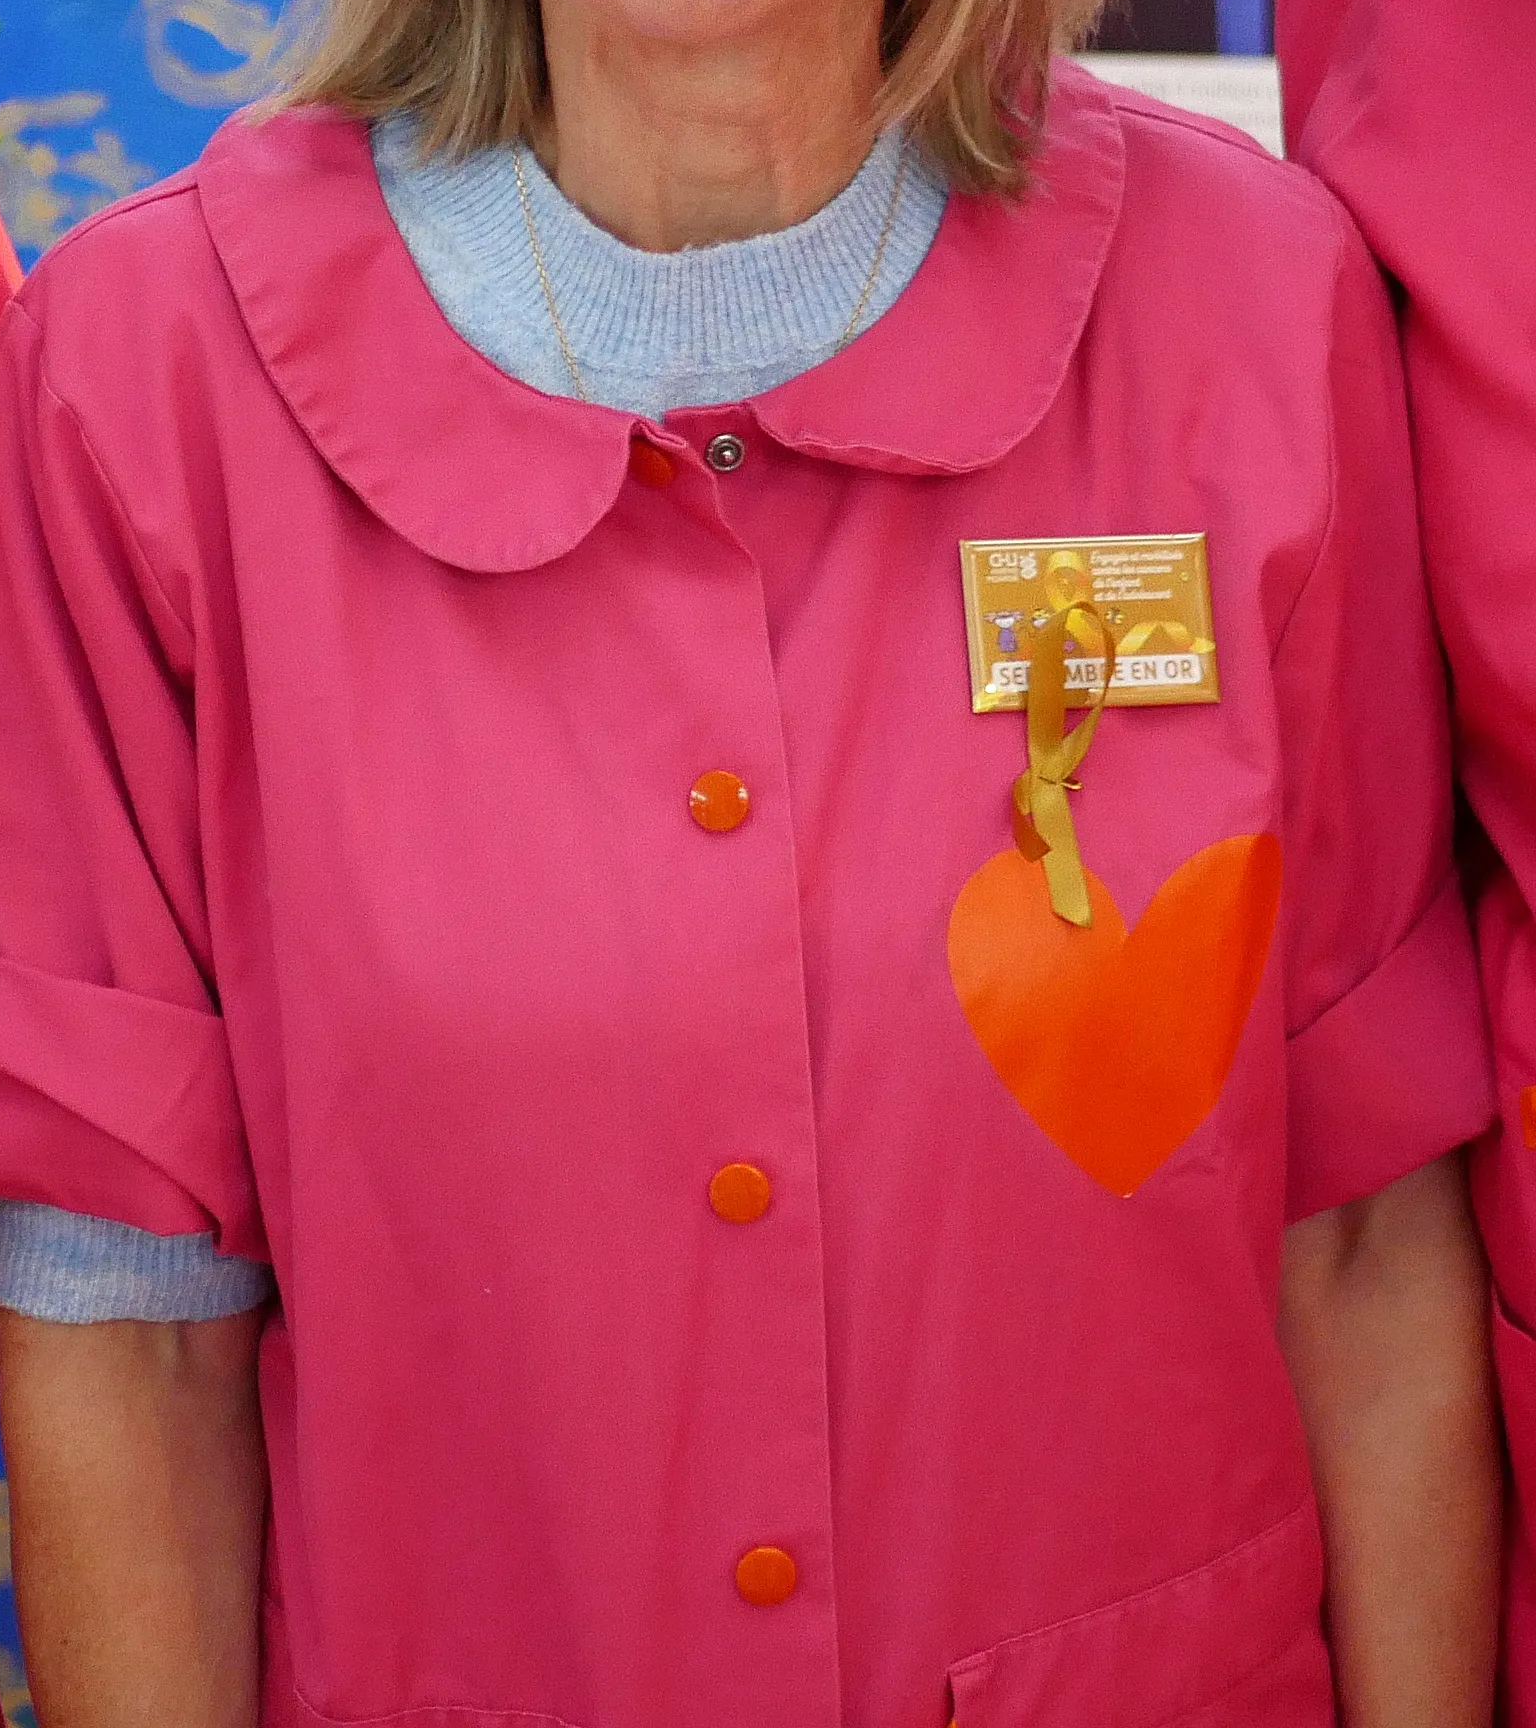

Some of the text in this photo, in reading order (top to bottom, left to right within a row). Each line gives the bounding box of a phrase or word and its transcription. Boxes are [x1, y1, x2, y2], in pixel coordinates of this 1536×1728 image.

[999, 658, 1194, 687] SEMBE EN OR
